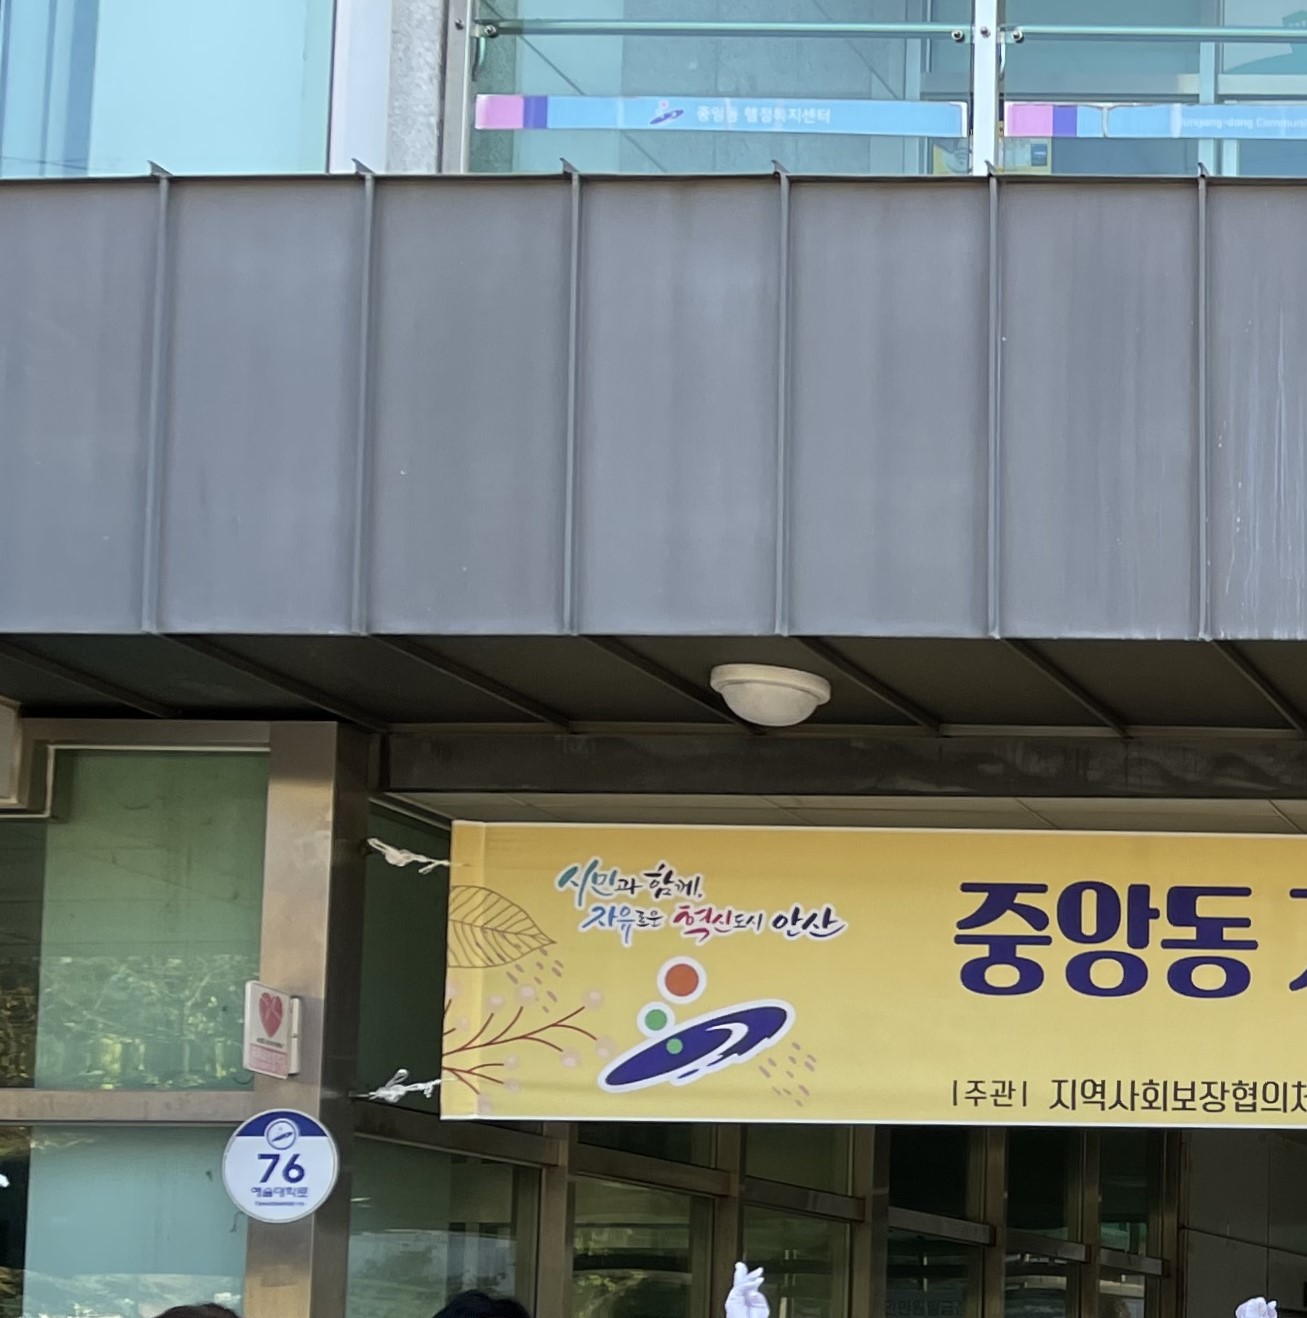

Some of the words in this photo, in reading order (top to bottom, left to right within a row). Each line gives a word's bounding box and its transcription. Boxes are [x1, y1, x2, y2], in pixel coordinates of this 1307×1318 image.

[558, 859, 641, 906] 시민과
[581, 906, 663, 944] 자유로운
[672, 905, 763, 942] 혁신도시
[772, 906, 846, 939] 안산
[953, 880, 1259, 999] 중앙동
[257, 1153, 305, 1184] 76
